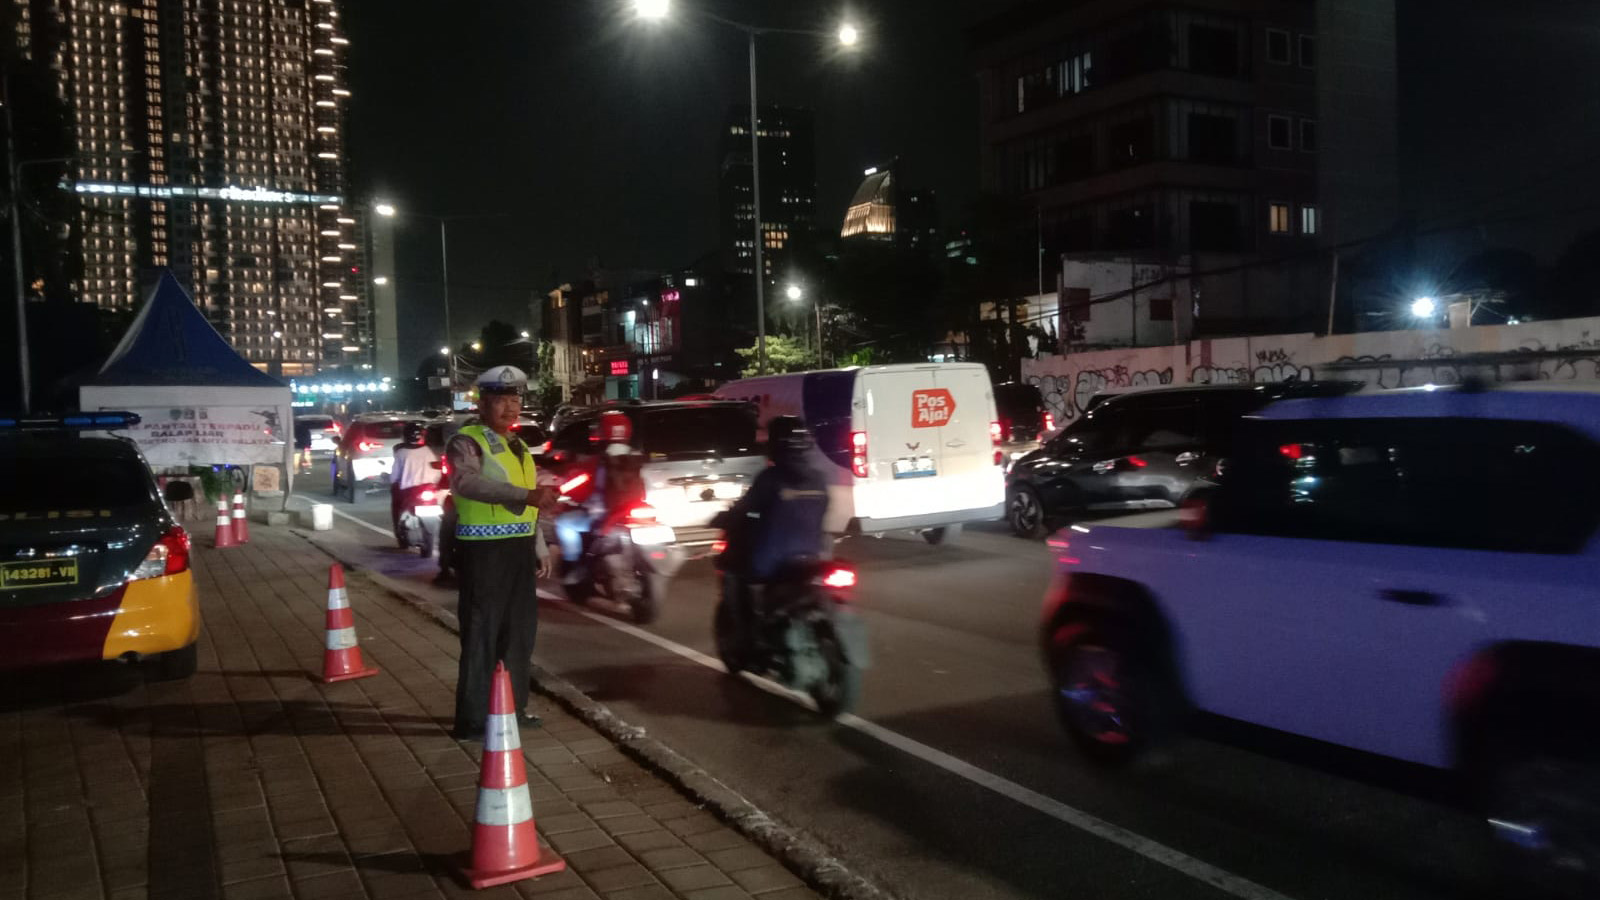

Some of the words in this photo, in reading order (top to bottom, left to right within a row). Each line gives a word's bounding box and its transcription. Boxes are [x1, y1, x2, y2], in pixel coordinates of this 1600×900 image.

[915, 394, 945, 407] Pos
[918, 407, 948, 424] Aja!
[144, 422, 196, 431] PANTAU
